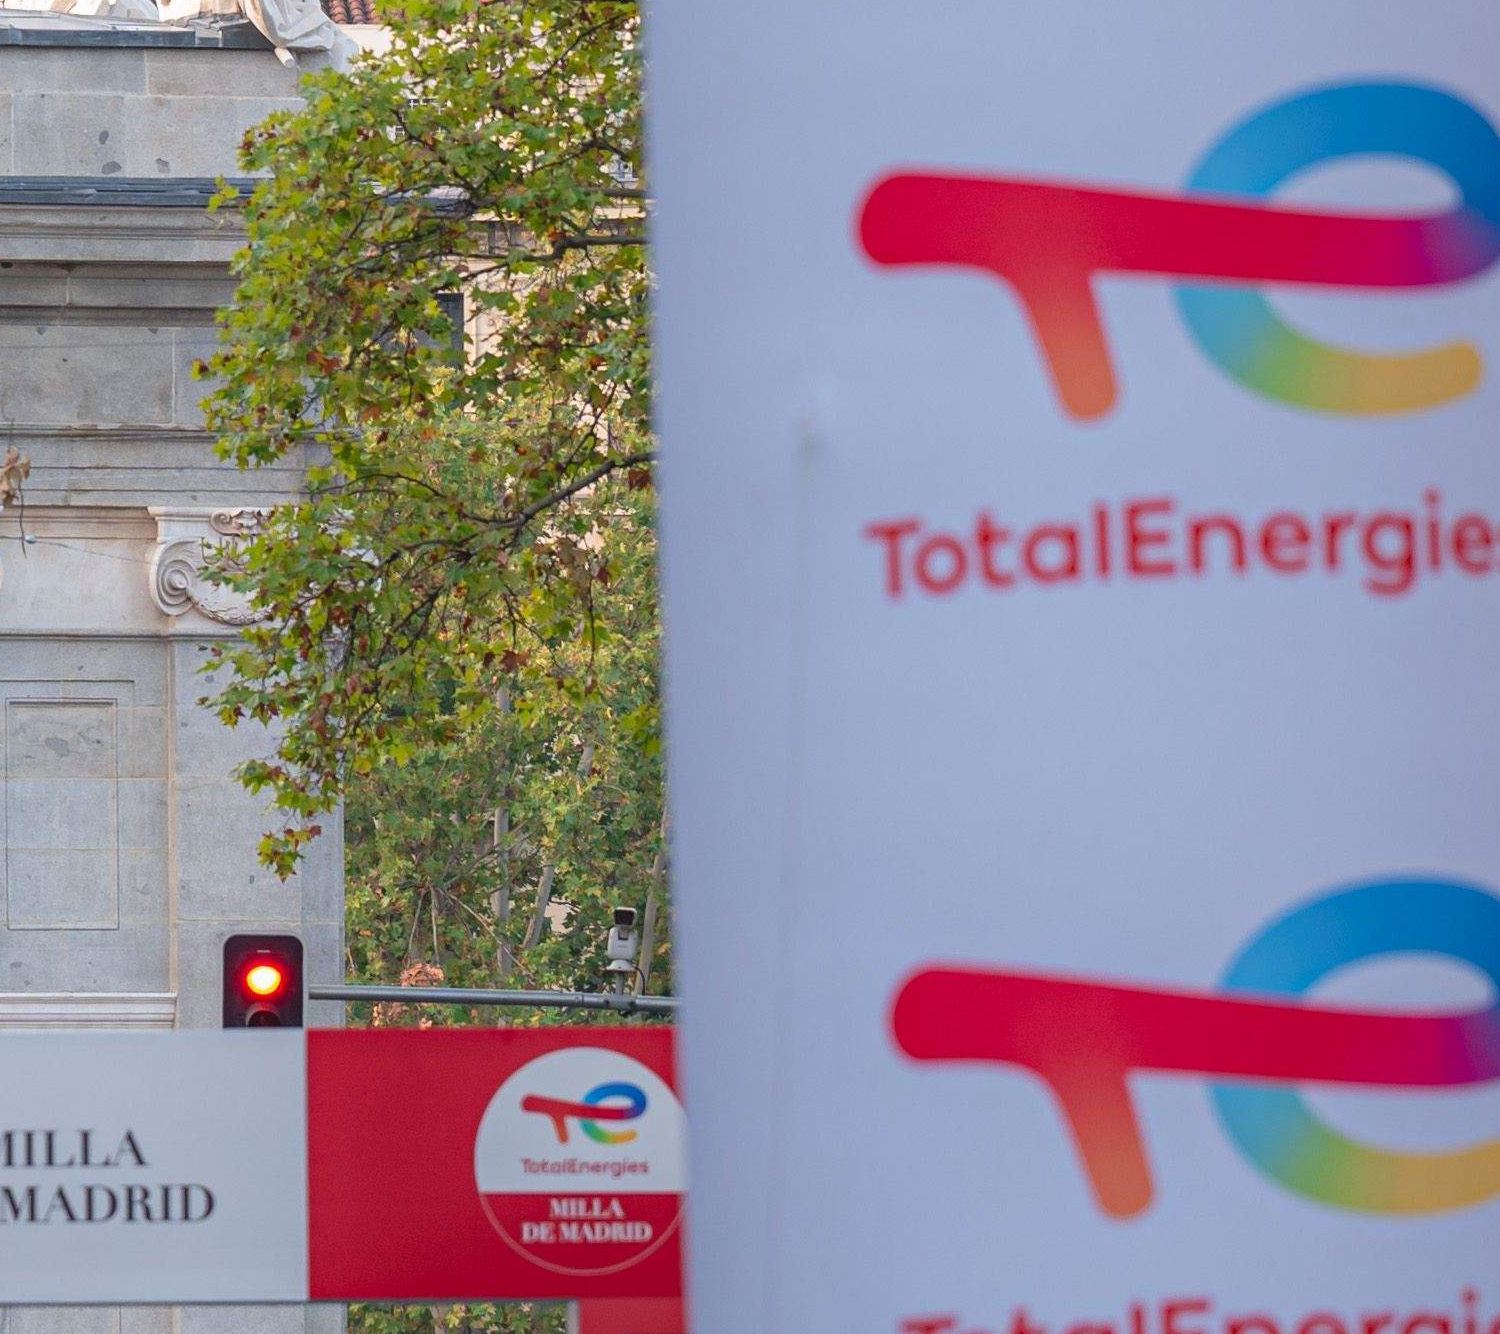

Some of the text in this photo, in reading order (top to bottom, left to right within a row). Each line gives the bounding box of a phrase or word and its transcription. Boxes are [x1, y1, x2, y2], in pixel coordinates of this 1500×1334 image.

[520, 1157, 652, 1179] TotalEnergies
[549, 1197, 625, 1218] MILLA
[520, 1221, 654, 1244] DE MADRID
